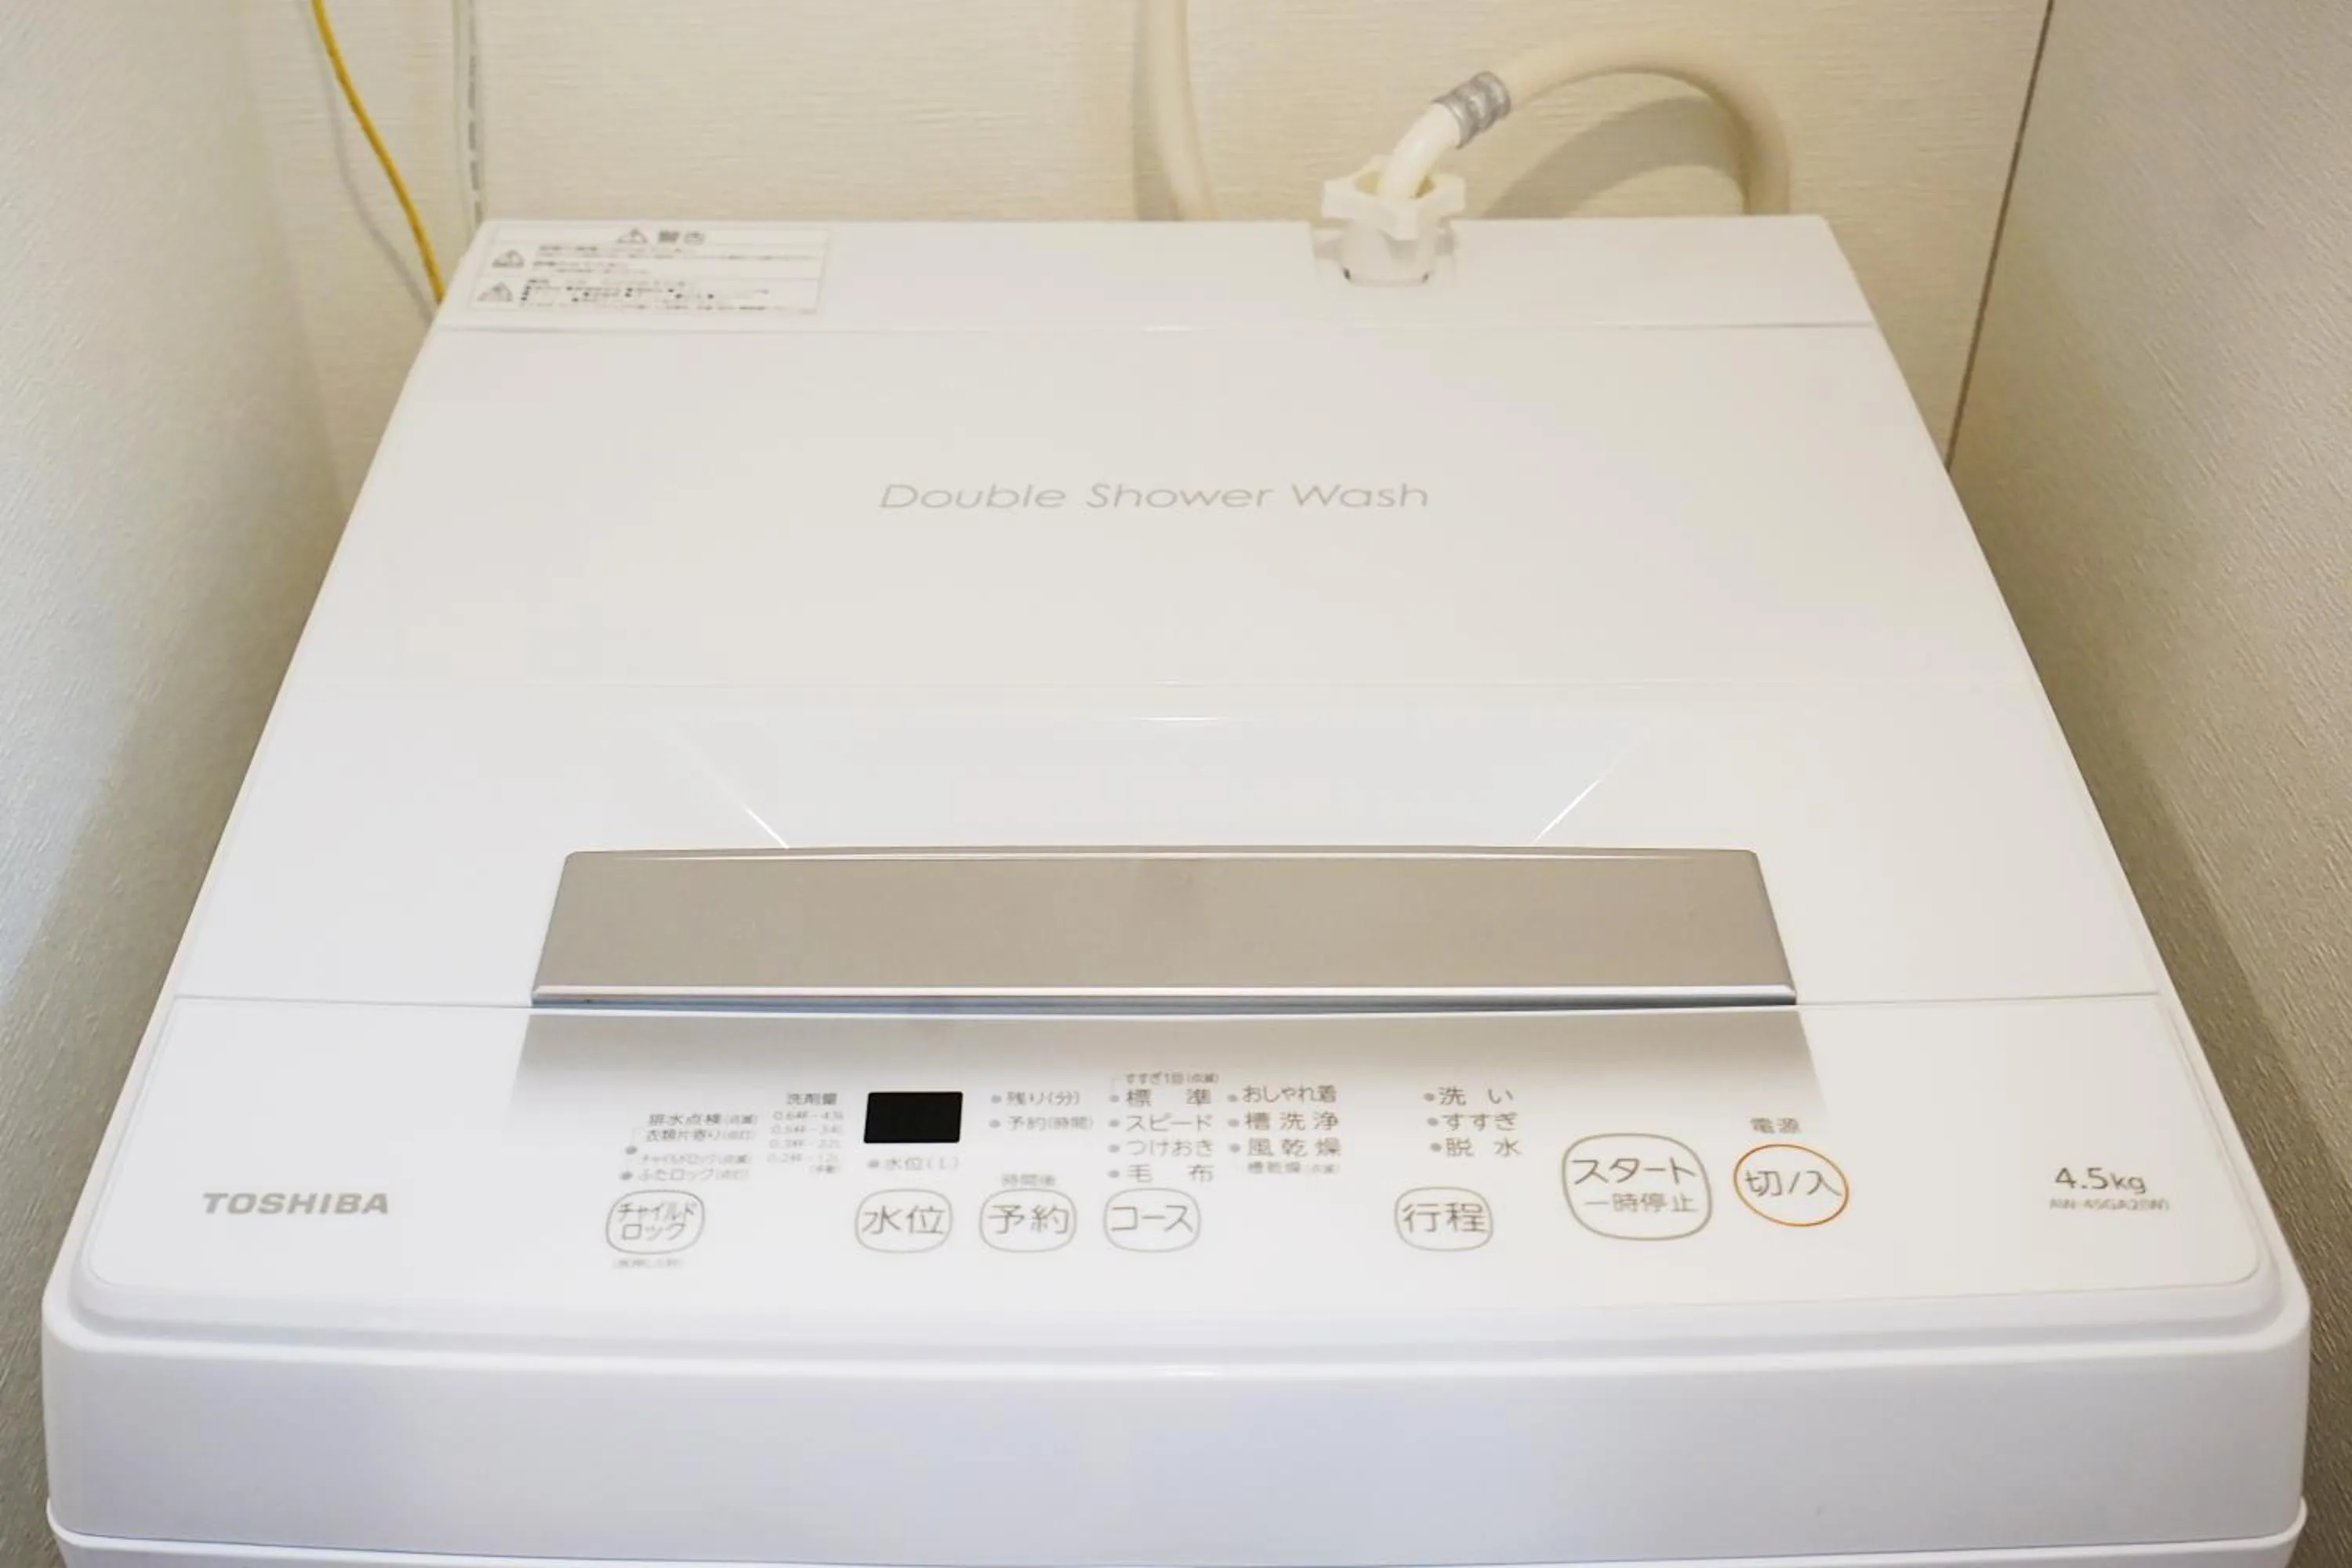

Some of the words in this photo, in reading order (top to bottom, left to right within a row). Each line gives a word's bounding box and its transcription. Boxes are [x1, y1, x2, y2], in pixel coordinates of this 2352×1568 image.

[879, 483, 1066, 510] Double
[1086, 482, 1274, 509] Shower
[1290, 483, 1428, 509] Wash
[1242, 1084, 1338, 1103] おしゃれ着
[1126, 1114, 1215, 1132] スピード
[1244, 1112, 1340, 1131] 槽洗浄
[1442, 1112, 1519, 1131] すすぎ
[1749, 1117, 1802, 1134] 電源
[1126, 1138, 1214, 1157] つけおき
[1247, 1138, 1342, 1157] 風乾燥
[1571, 1156, 1697, 1185] スタート
[2055, 1167, 2147, 1195] 4.5kg
[1744, 1170, 1842, 1198] 切/入
[202, 1192, 389, 1215] TOSHIBA
[617, 1202, 698, 1222] チャイルド
[1585, 1192, 1698, 1213] 一時停止
[862, 1204, 947, 1236] 水位
[987, 1204, 1070, 1236] 予約
[1111, 1204, 1194, 1233] コース
[1402, 1202, 1487, 1233] 行程
[622, 1223, 687, 1242] ロック
